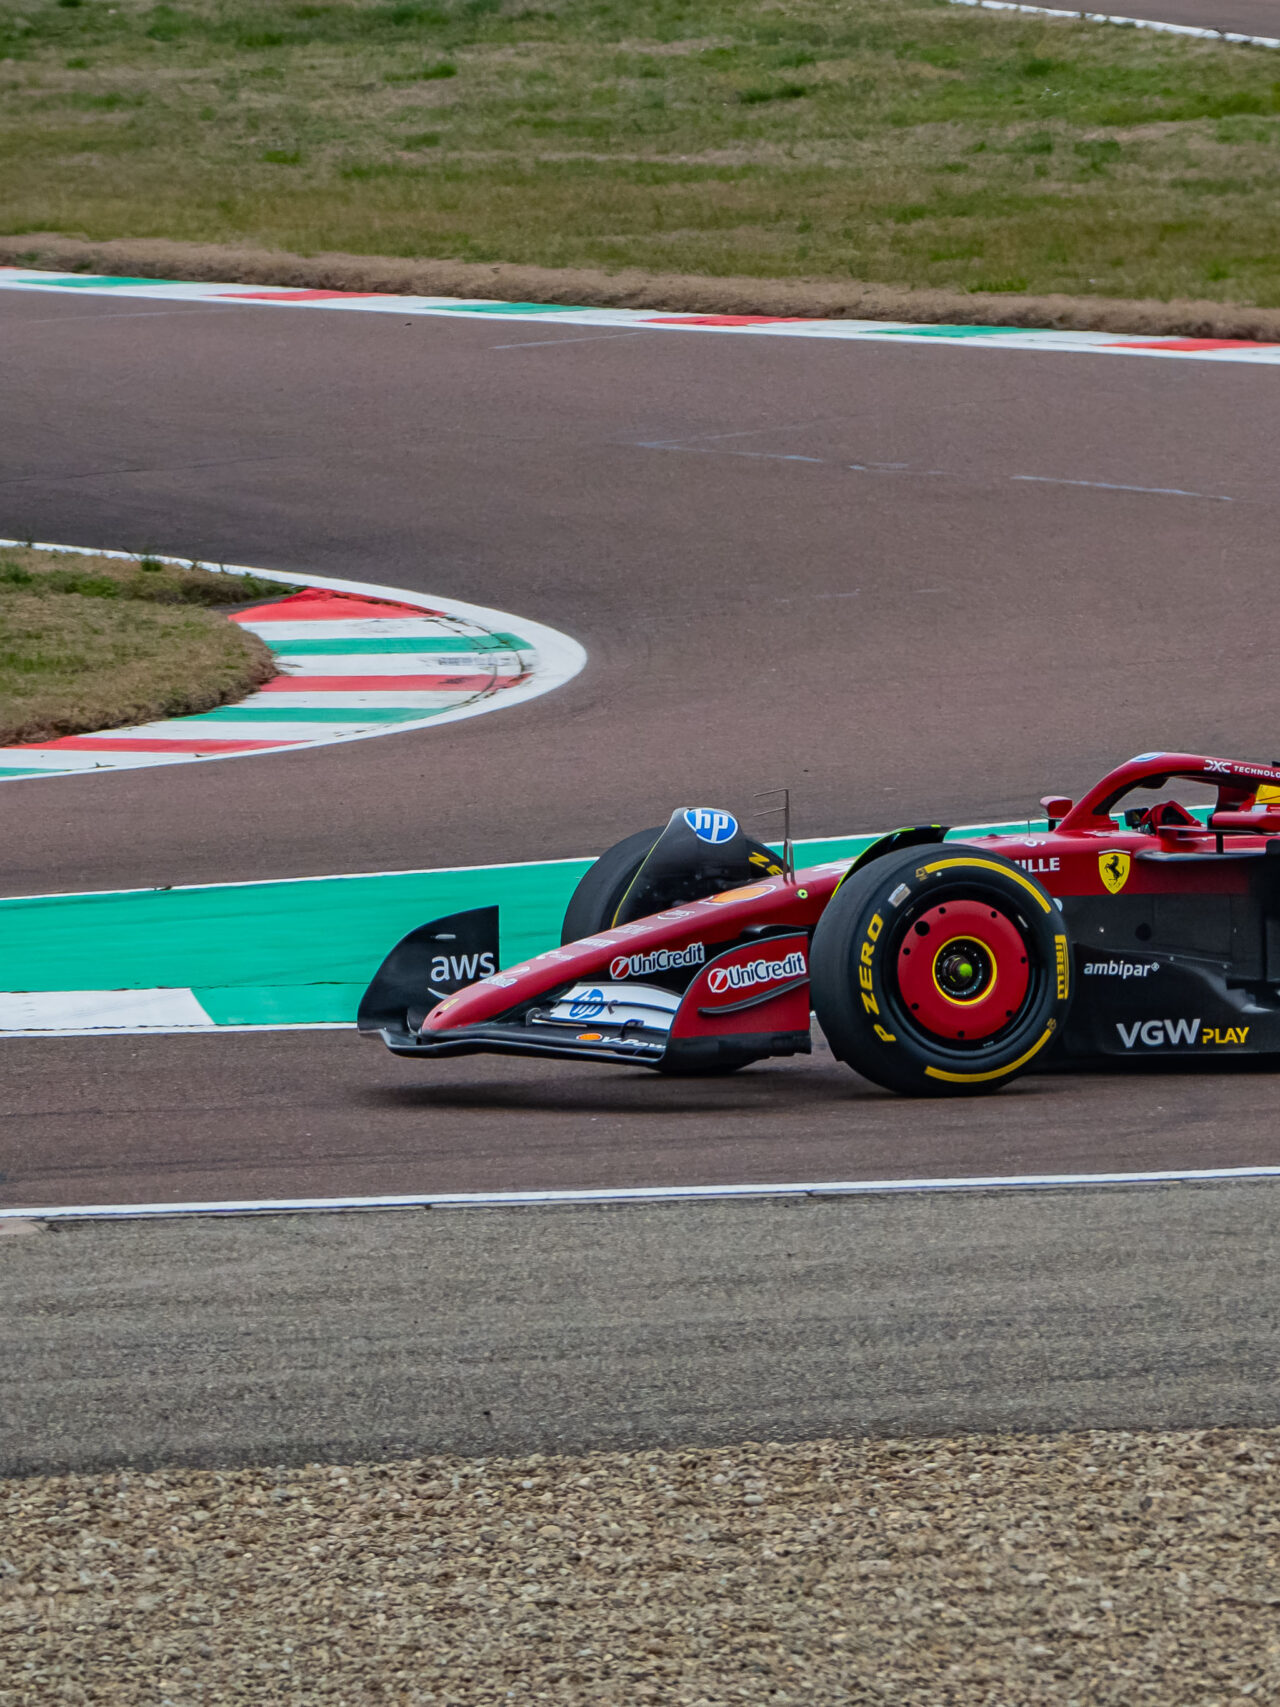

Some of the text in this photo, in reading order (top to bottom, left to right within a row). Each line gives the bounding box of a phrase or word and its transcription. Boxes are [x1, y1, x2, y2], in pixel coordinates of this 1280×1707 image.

[1203, 759, 1232, 773] DXC
[693, 808, 730, 843] hp
[1015, 857, 1060, 873] ILLE
[430, 952, 496, 983] aws
[629, 942, 705, 976] UniCredit
[728, 952, 806, 988] UniCredit
[1083, 959, 1151, 980] ambipar
[859, 912, 897, 1042] P ZERO
[1115, 1018, 1250, 1048] VGW PLAY
